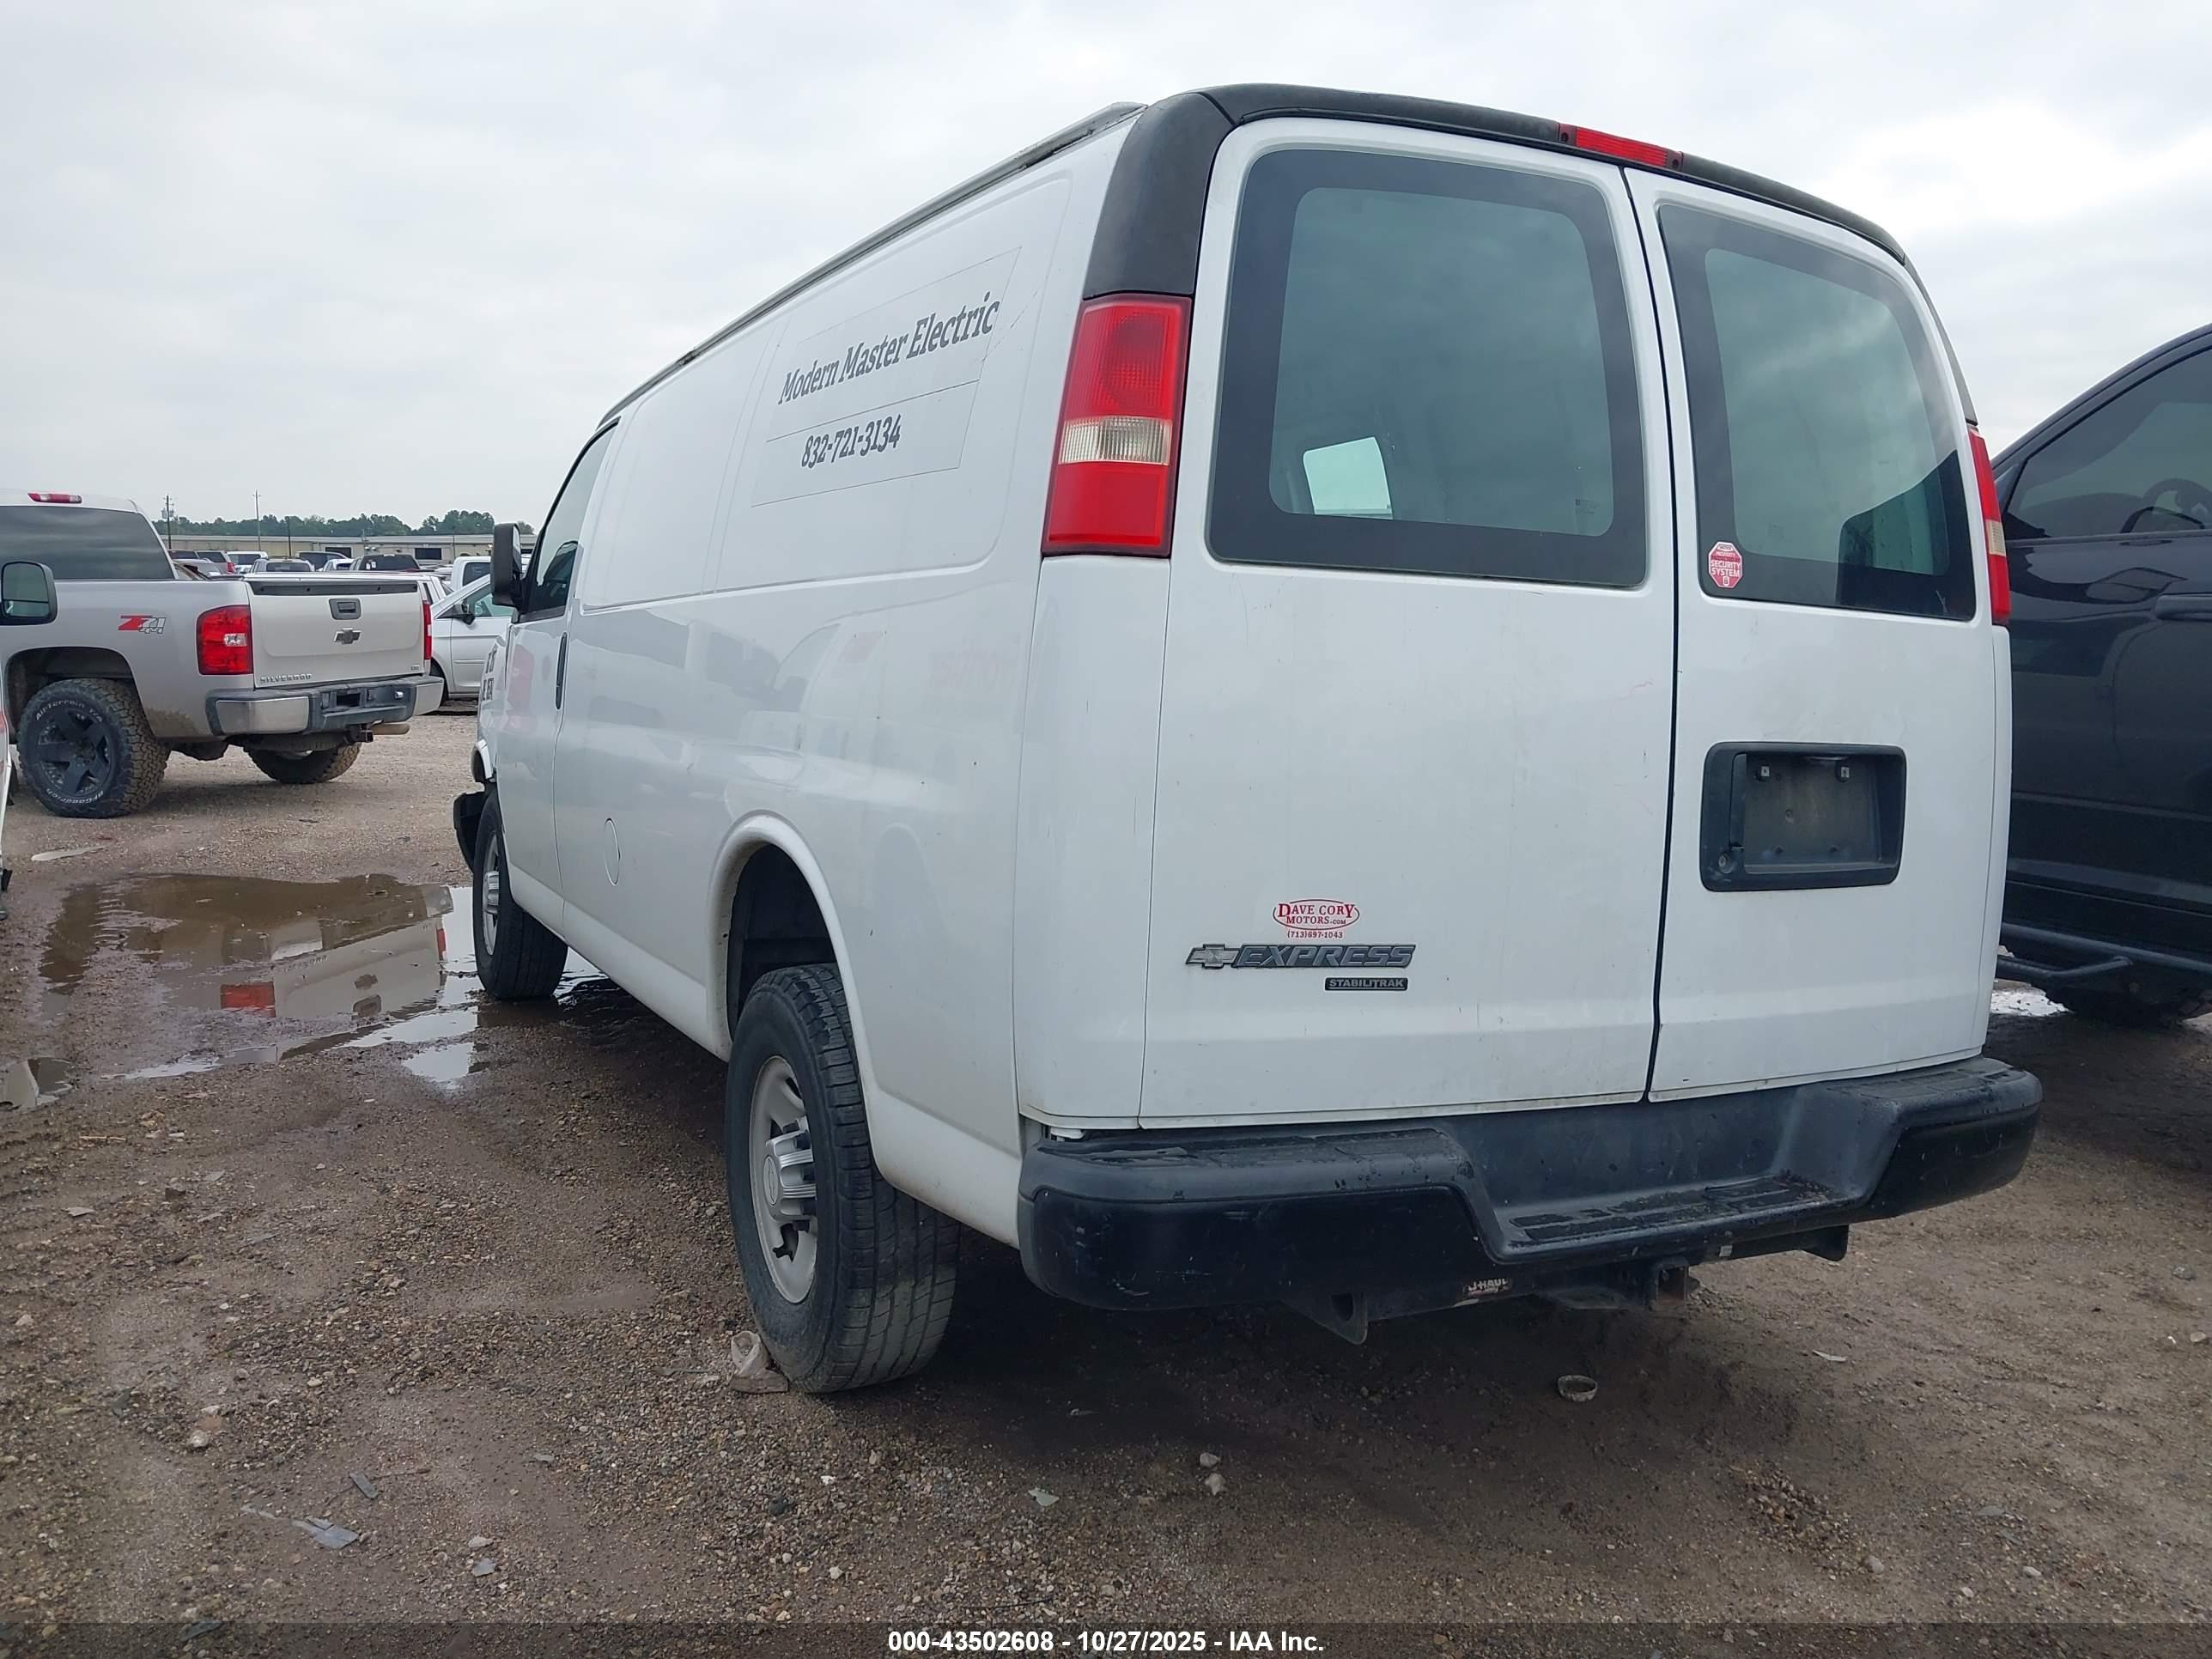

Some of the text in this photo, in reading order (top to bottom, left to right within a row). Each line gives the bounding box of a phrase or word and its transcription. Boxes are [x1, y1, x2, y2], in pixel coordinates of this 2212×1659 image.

[778, 291, 1000, 405] Modern Master Electric
[801, 414, 902, 469] 832-721-3134
[1711, 560, 1741, 569] SECURITY
[1711, 568, 1740, 578] SYSTEM
[1277, 902, 1355, 919] DAVE CORY
[1236, 945, 1415, 968] EXPRESS
[1328, 978, 1405, 988] STABILITRAK
